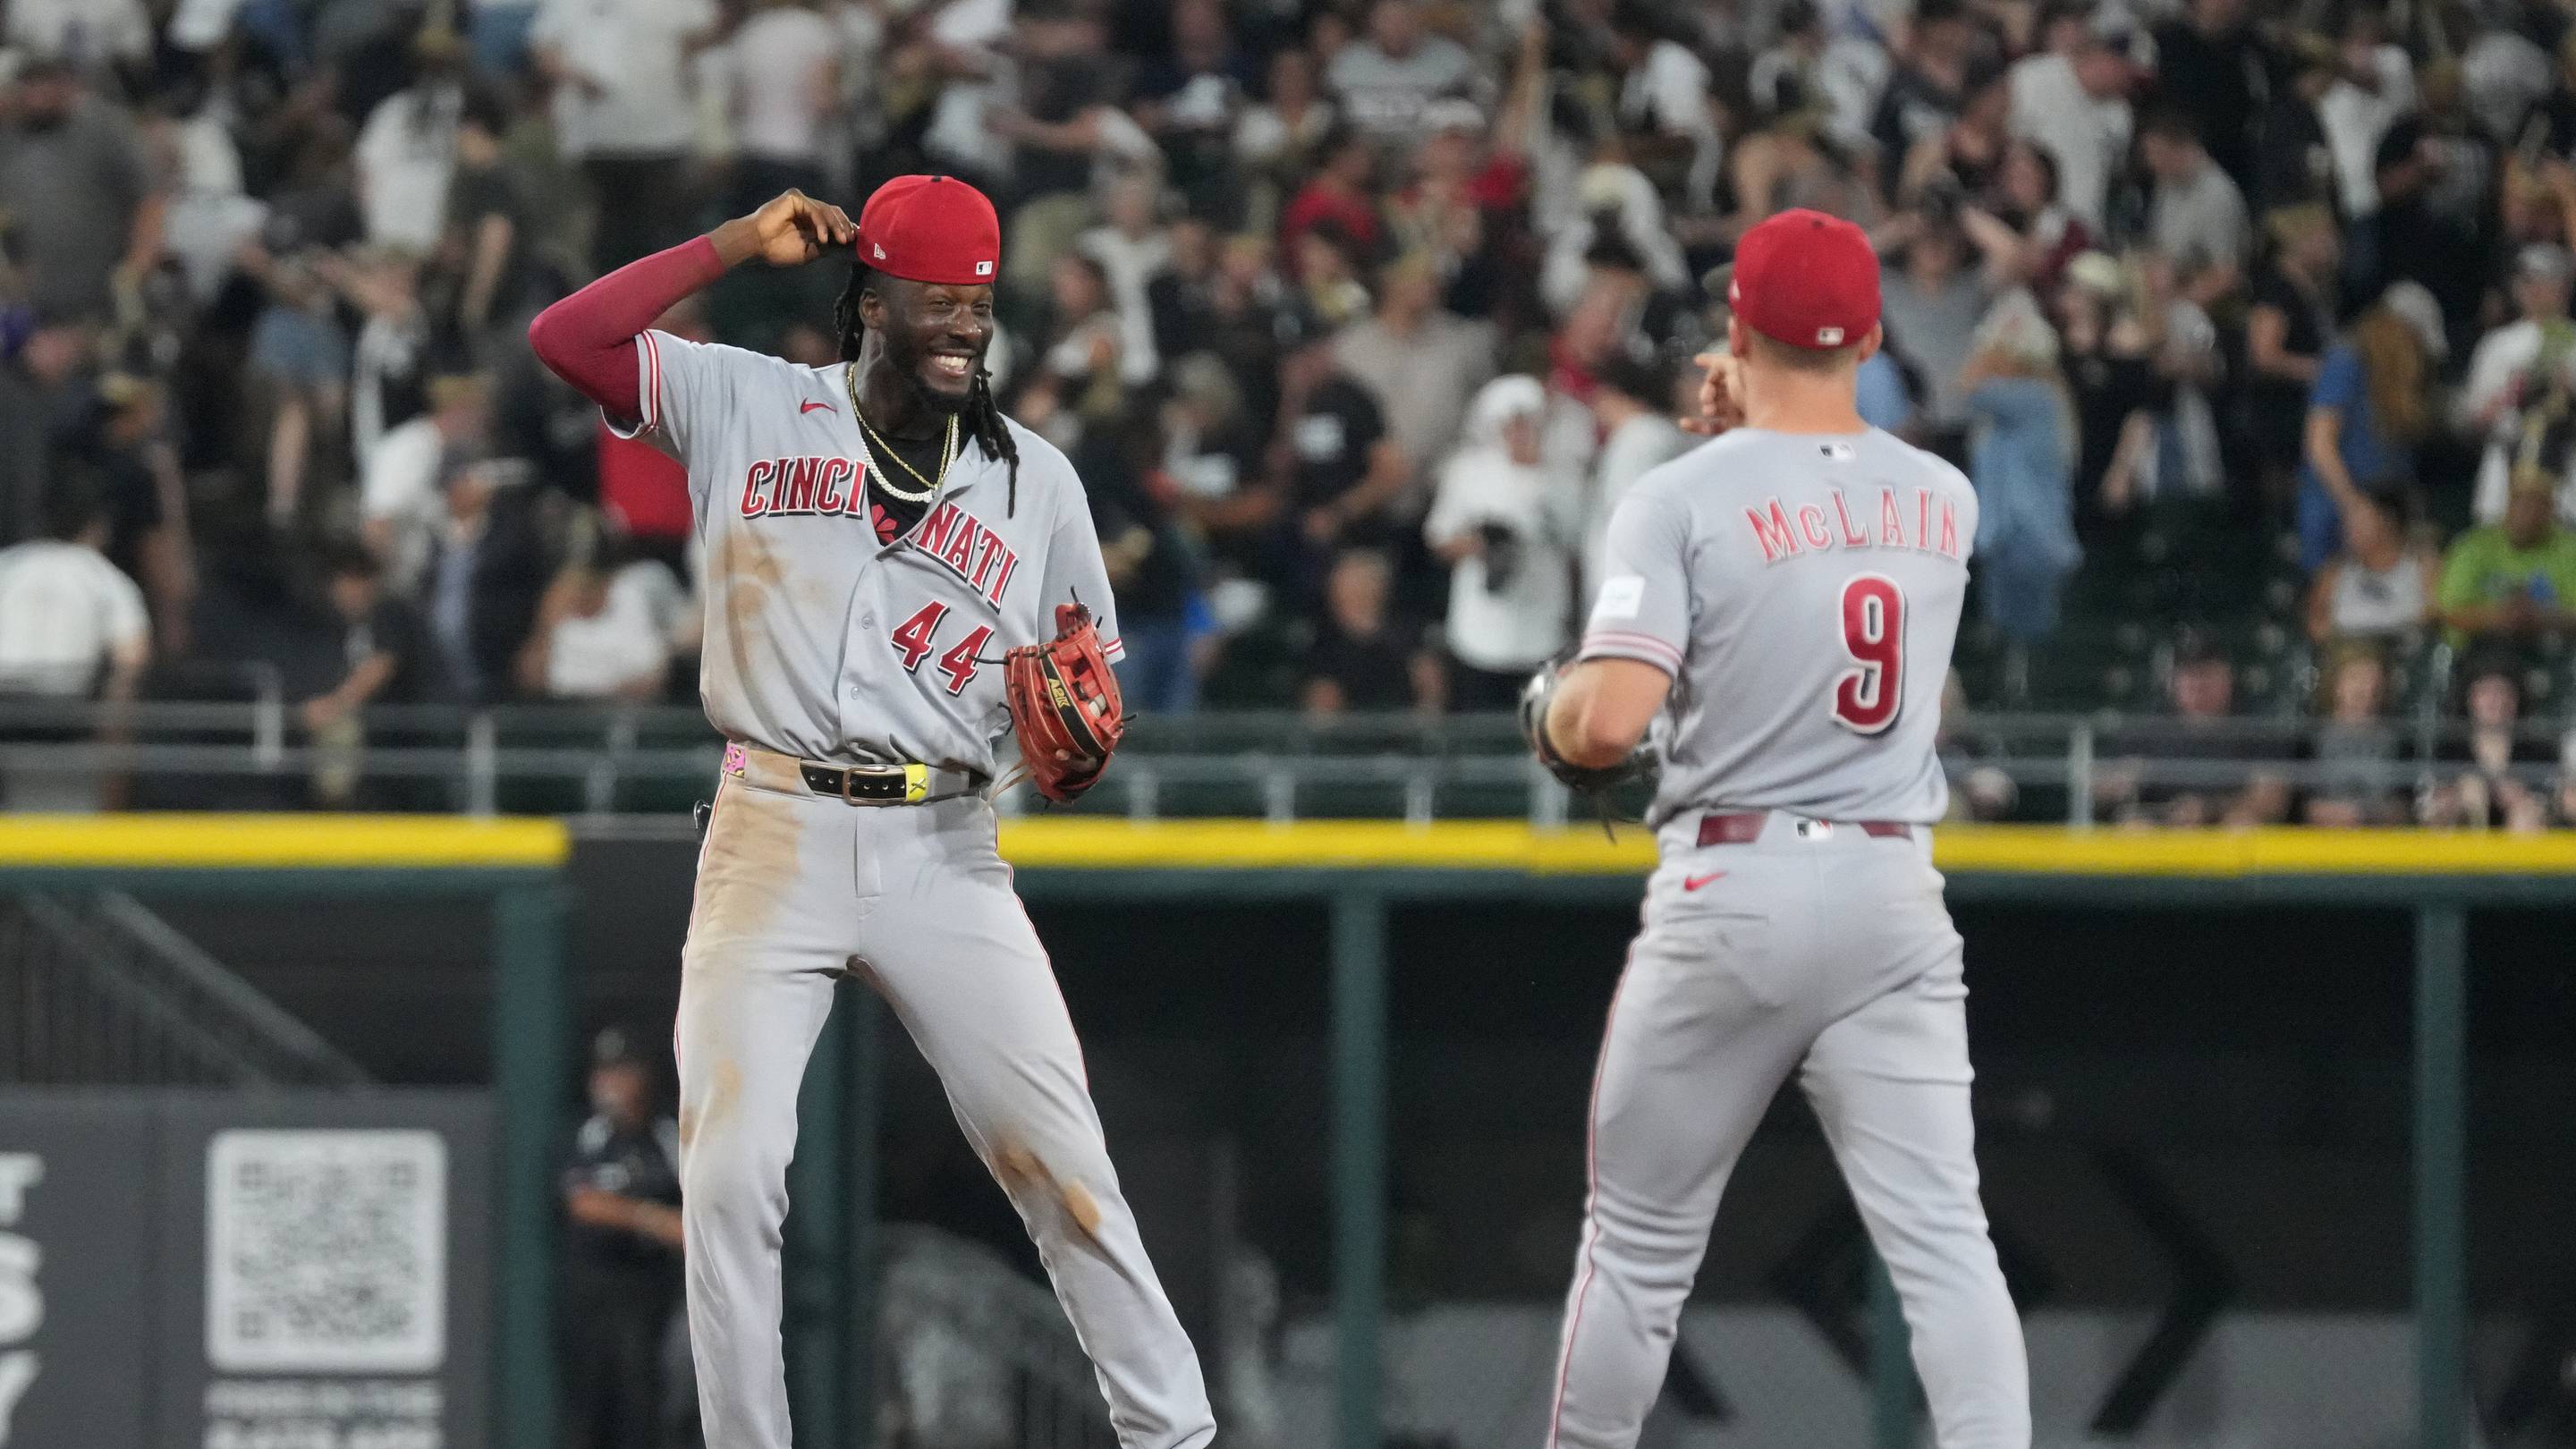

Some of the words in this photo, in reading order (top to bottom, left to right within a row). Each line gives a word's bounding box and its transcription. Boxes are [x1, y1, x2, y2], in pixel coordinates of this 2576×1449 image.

[740, 457, 1019, 614] CINCINATI
[892, 601, 995, 697] 44
[1048, 678, 1072, 709] A2K
[1833, 573, 1908, 734] 9
